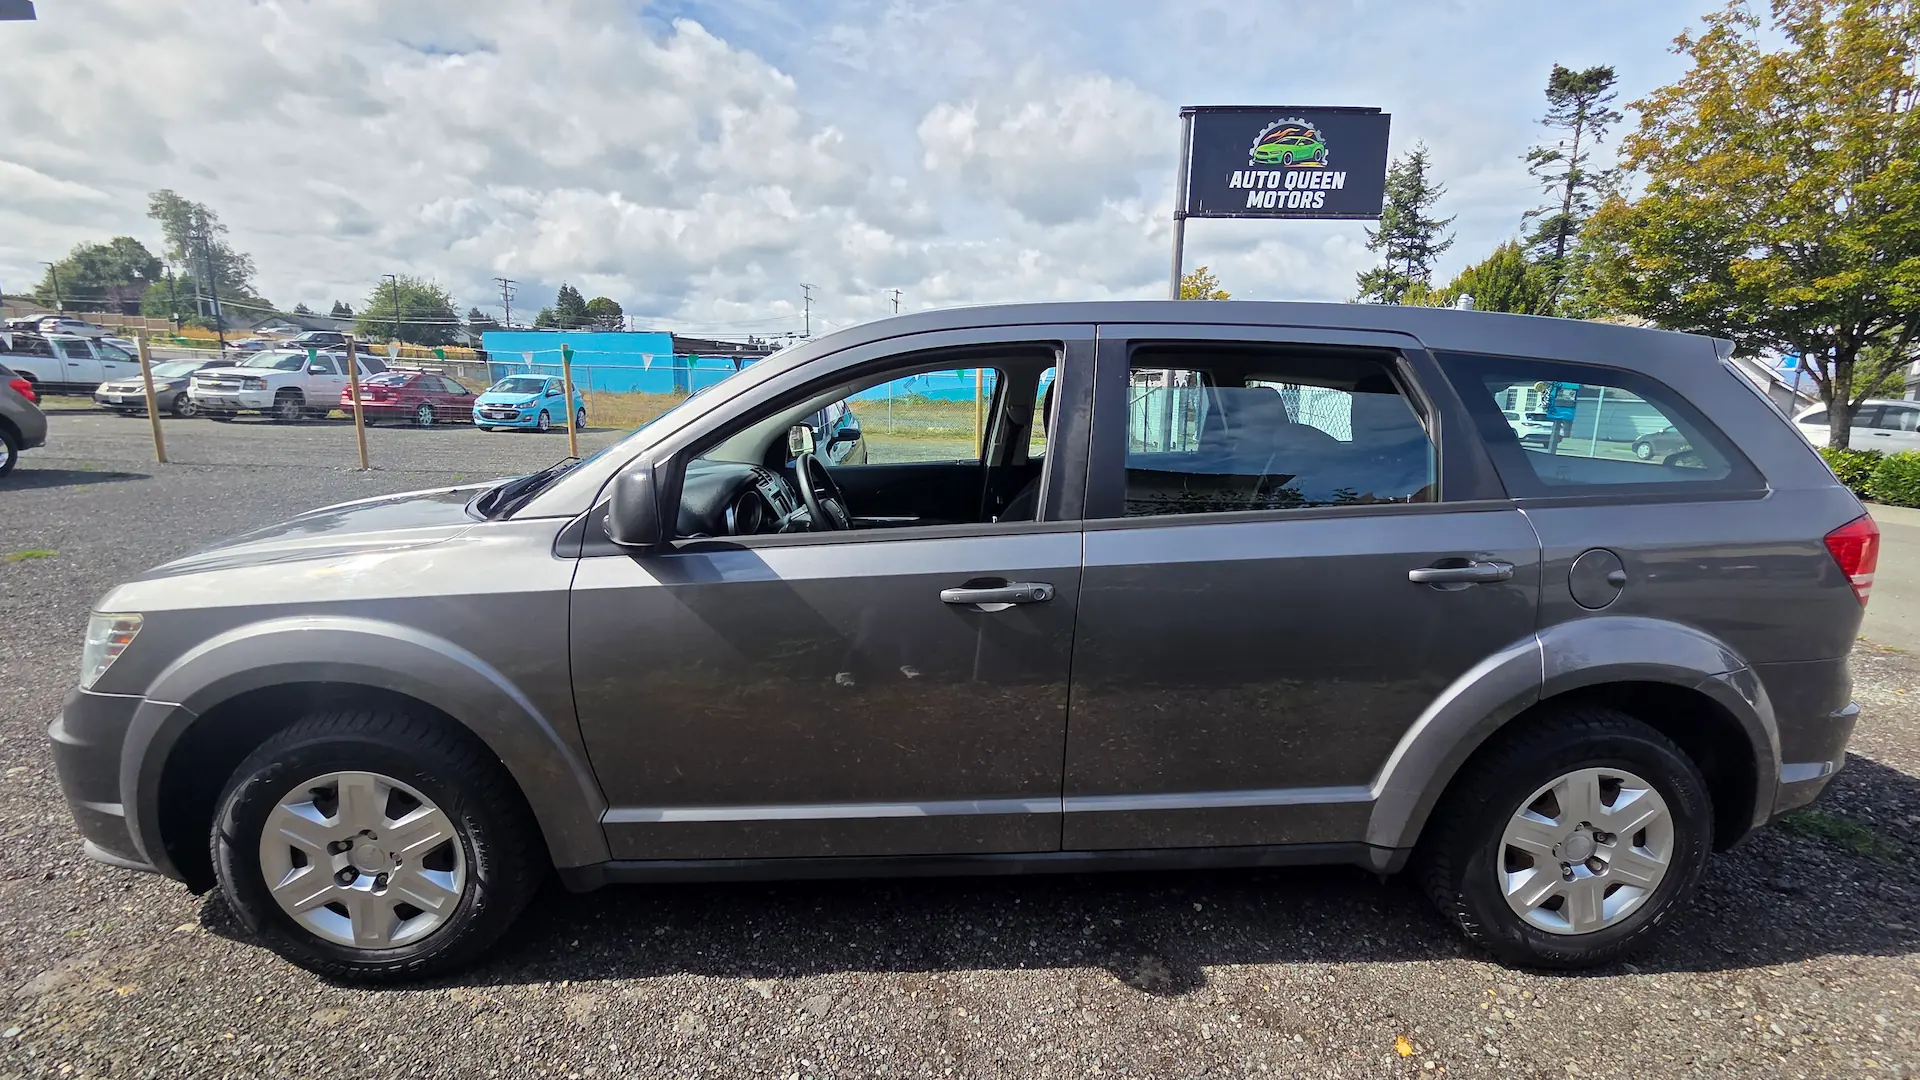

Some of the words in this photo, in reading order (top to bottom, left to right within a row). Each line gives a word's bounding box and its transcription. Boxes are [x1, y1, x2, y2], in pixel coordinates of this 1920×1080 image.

[1229, 170, 1281, 189] AUTO
[1284, 171, 1346, 191] QUEEN
[1246, 190, 1325, 209] MOTORS
